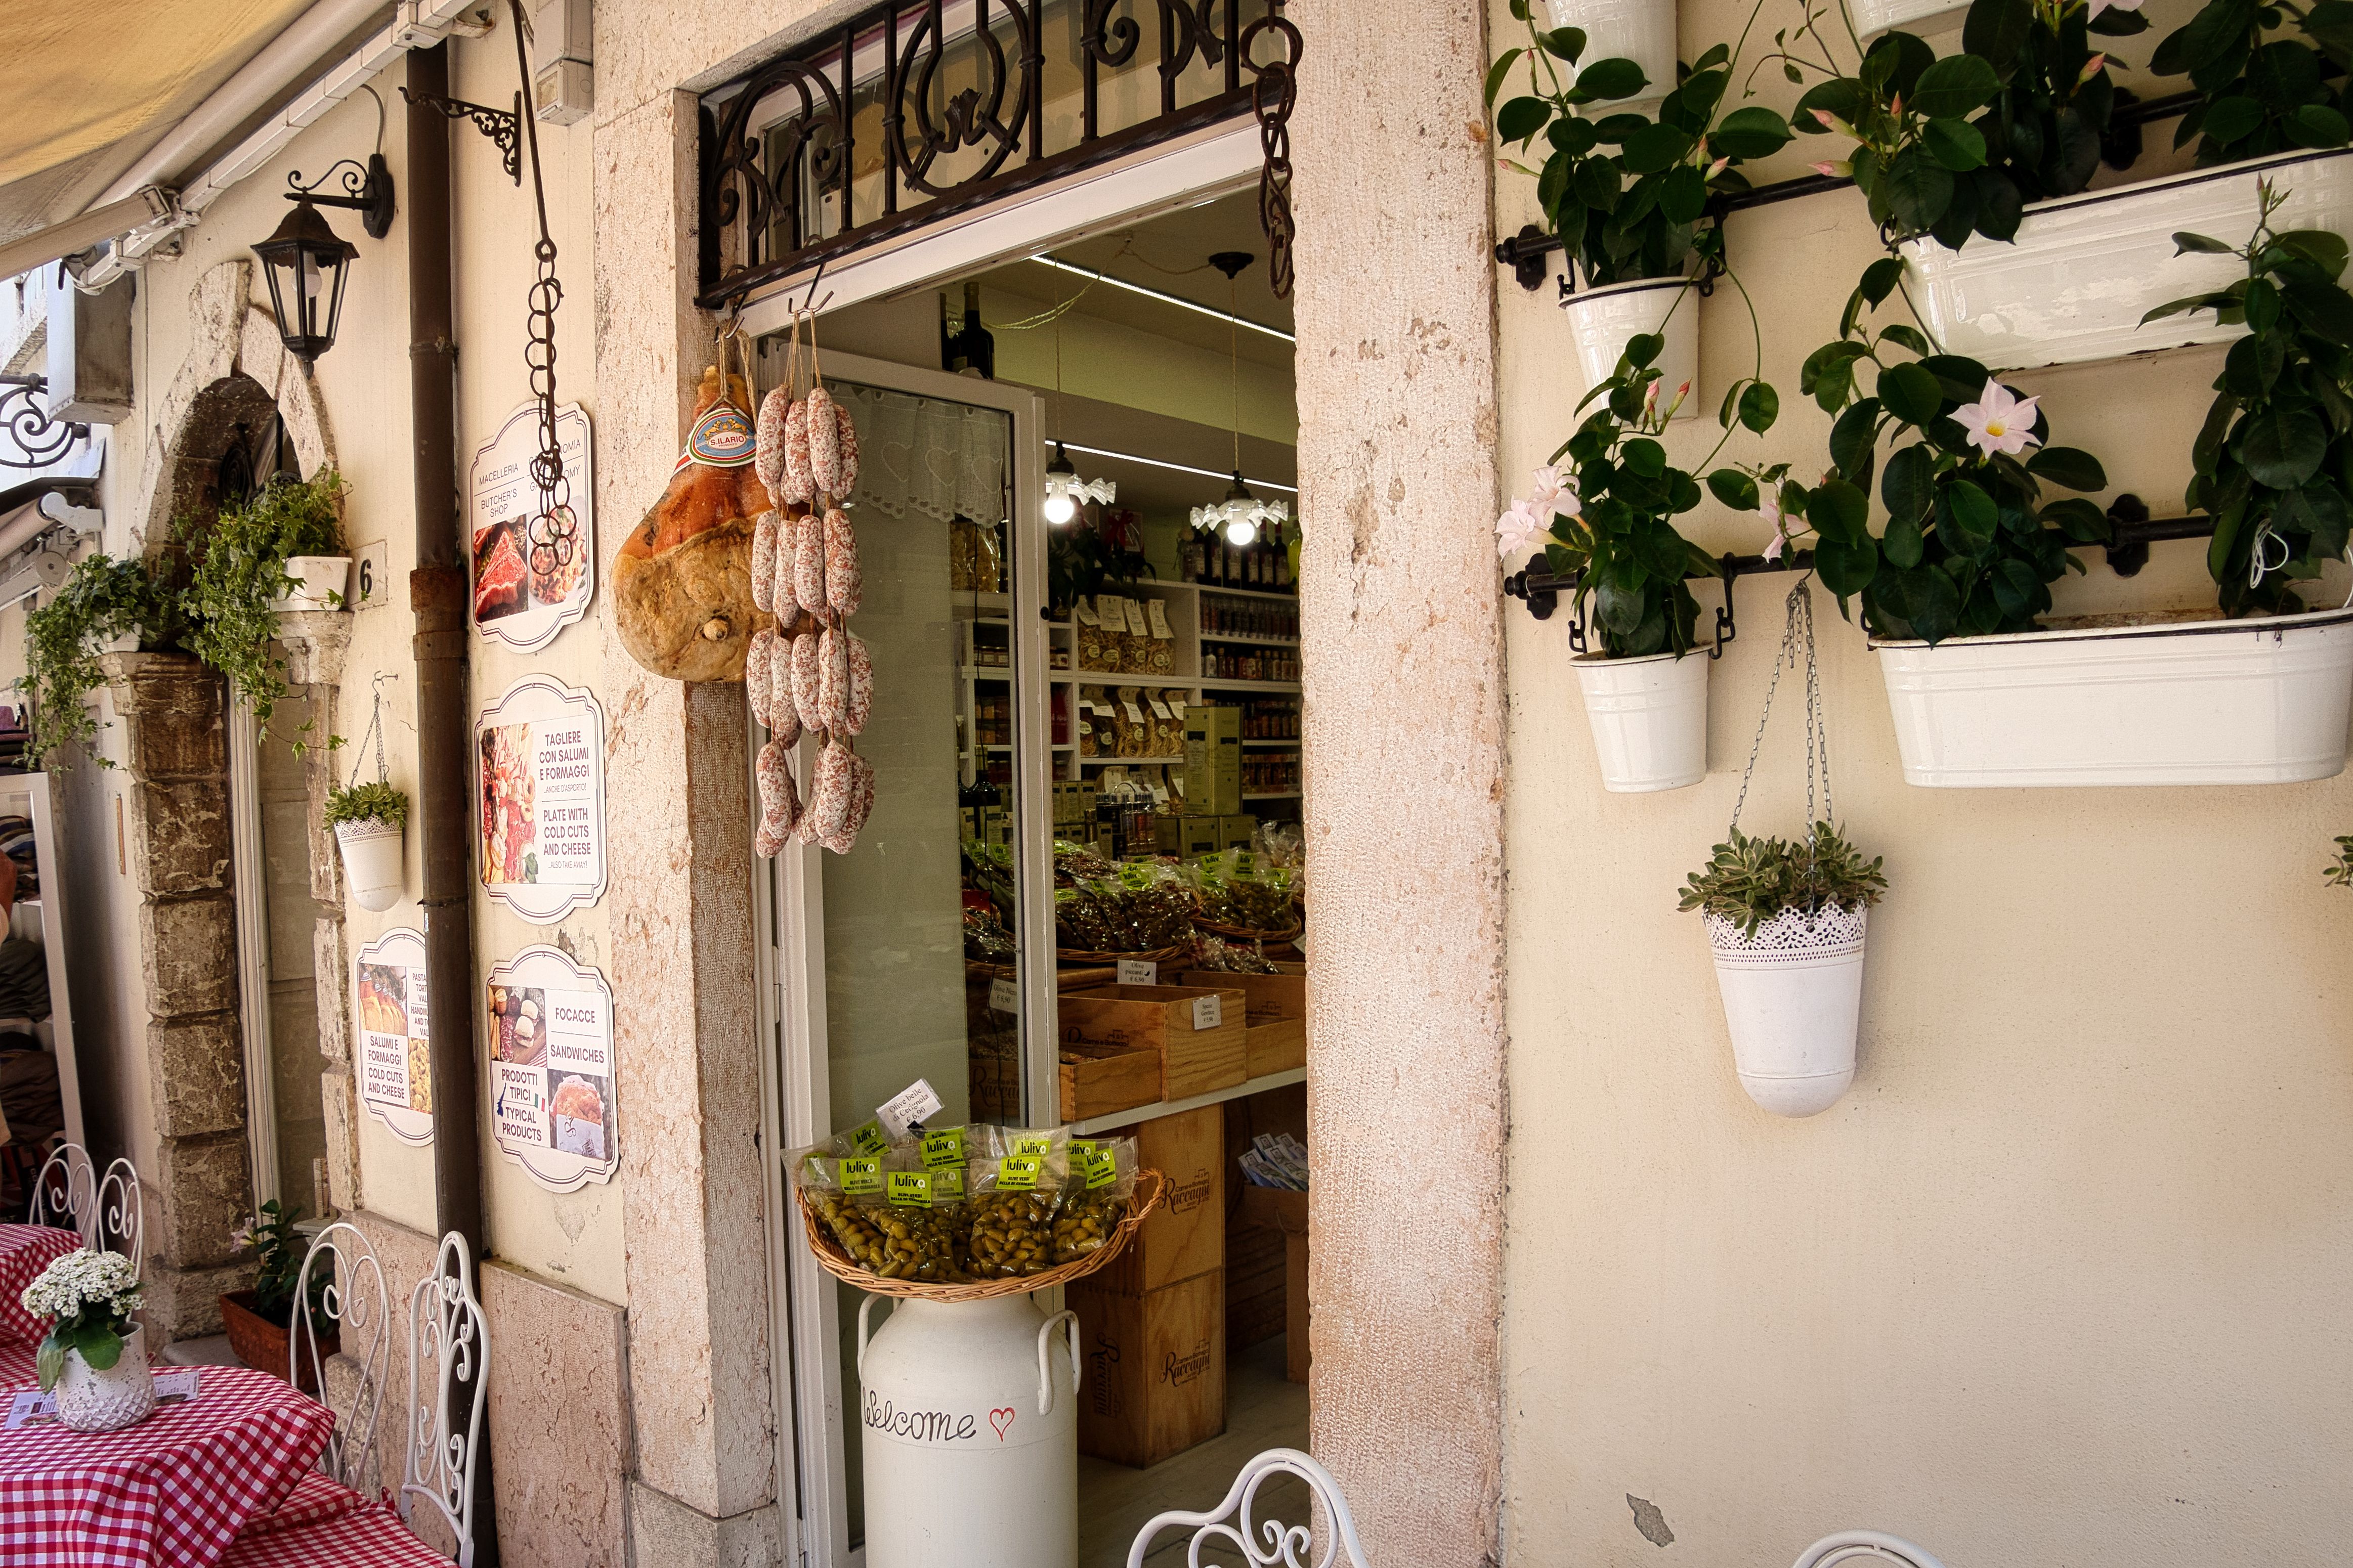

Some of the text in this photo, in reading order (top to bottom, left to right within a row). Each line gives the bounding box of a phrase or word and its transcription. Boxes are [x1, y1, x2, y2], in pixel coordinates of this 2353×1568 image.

[710, 435, 744, 446] S.ILARIO
[479, 463, 519, 486] MACELLERIA
[481, 488, 517, 509] BUTCHER'S
[490, 504, 508, 517] SHOP
[360, 559, 372, 595] 6
[545, 730, 581, 746] TAGLIERE
[539, 747, 589, 763] CON SALUMI
[540, 764, 589, 780] E FORMAGGI
[544, 807, 588, 822] PLATE WITH
[544, 825, 589, 838] COLD CUTS
[544, 842, 591, 855] AND CHEESE
[412, 973, 426, 982] PASTA
[415, 1017, 423, 1025] AND
[555, 1008, 595, 1023] FOCACCE
[370, 1036, 398, 1050] SALUMI E
[368, 1050, 402, 1066] FORMAGGI
[550, 1044, 604, 1063] SANDWICHES
[368, 1067, 403, 1083] COLD CUTS
[502, 1068, 538, 1086] PRODOTTI
[368, 1082, 405, 1099] AND CHEESE
[510, 1086, 531, 1102] TIPICI
[889, 1088, 922, 1113] Olive belle
[900, 1094, 929, 1116] Cerignola
[505, 1106, 537, 1124] TYPICAL
[912, 1107, 926, 1121] 6,90
[502, 1122, 542, 1142] PRODUCTS
[863, 1386, 976, 1442] Welcome
